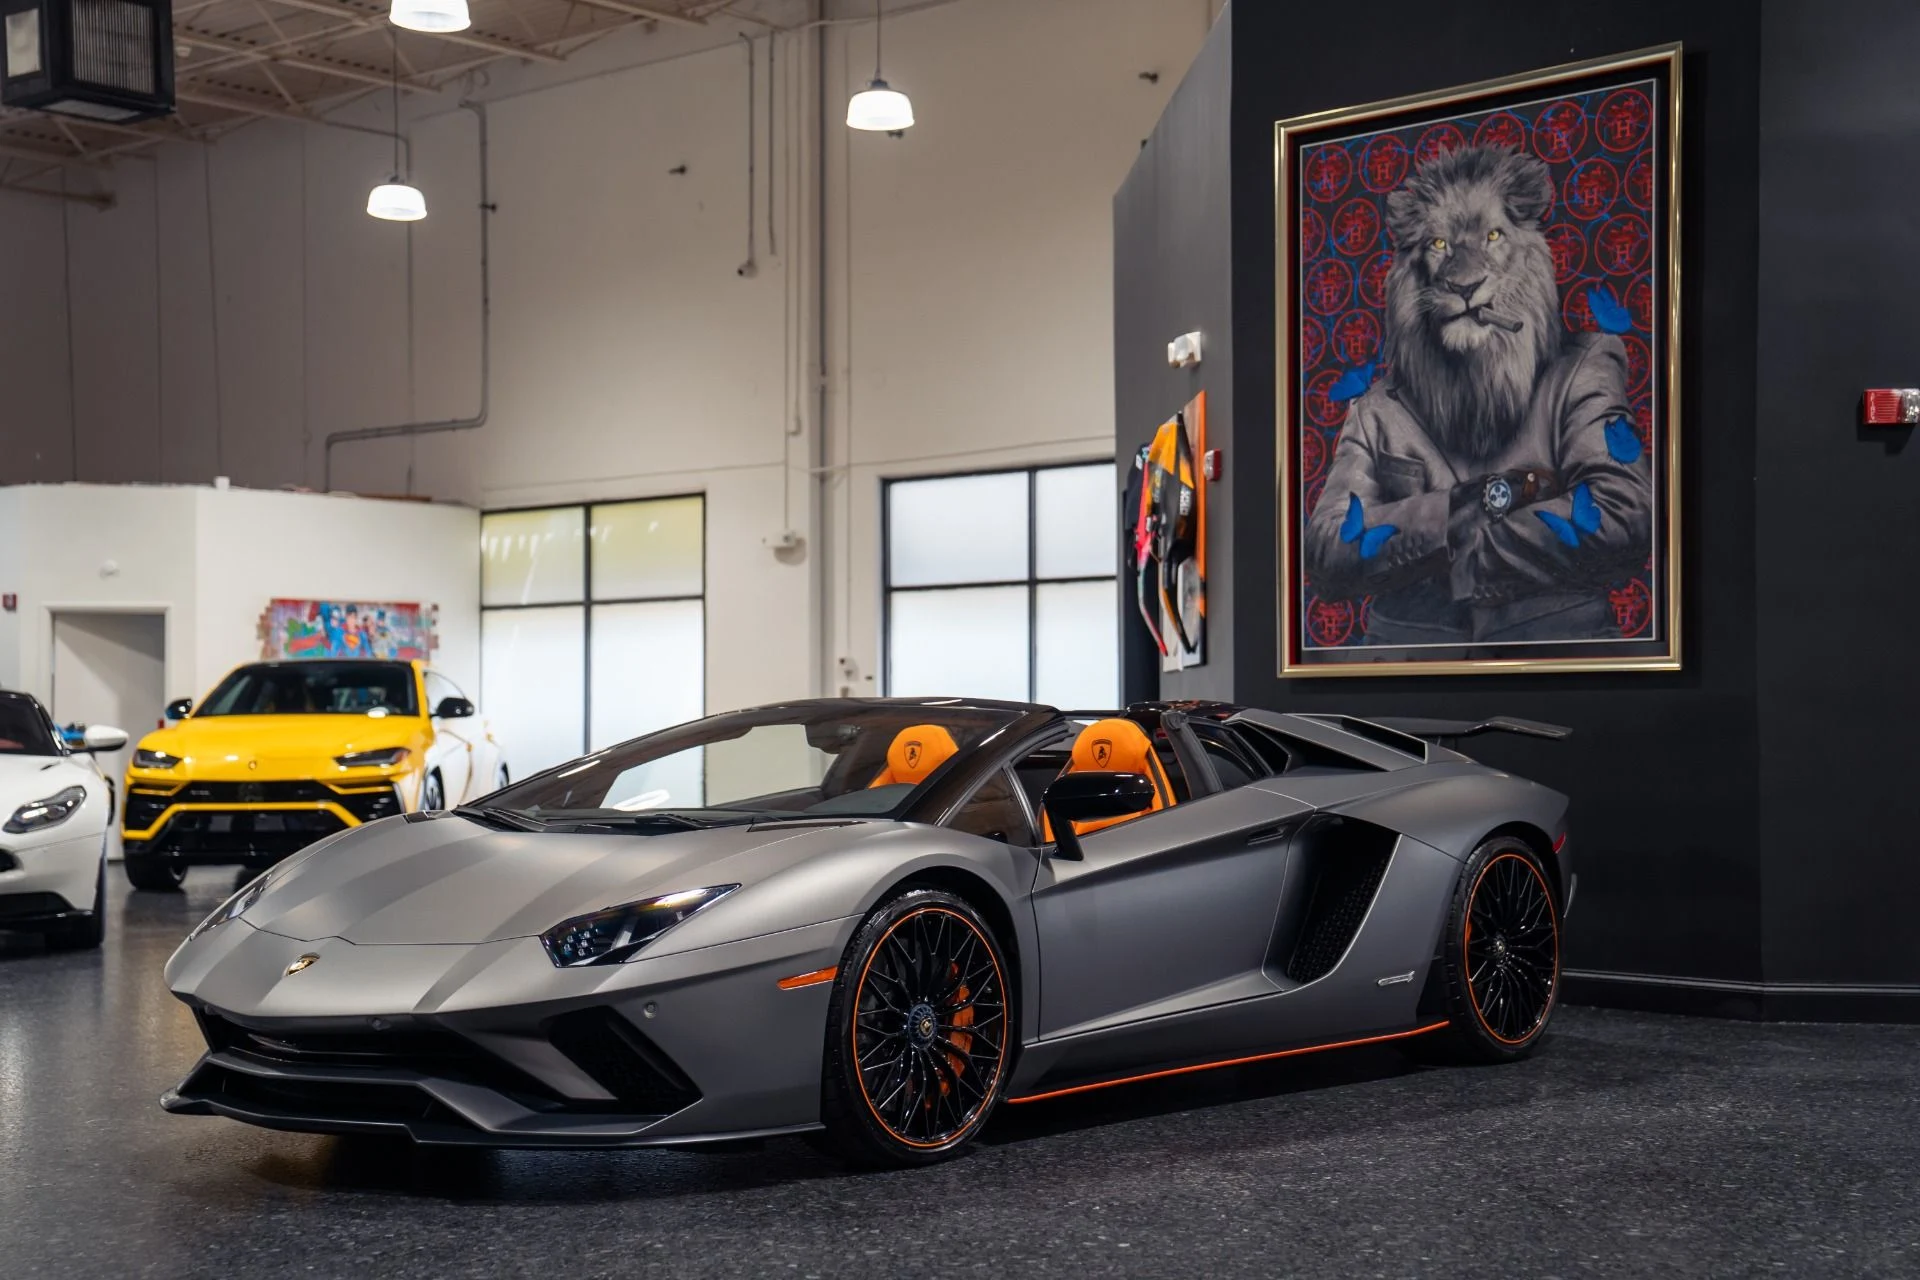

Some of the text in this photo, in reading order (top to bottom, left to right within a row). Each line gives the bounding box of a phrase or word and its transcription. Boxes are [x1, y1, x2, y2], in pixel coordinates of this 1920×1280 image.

[1614, 119, 1632, 138] H
[1375, 163, 1392, 181] H
[1583, 187, 1602, 207] H
[1615, 244, 1634, 263] H
